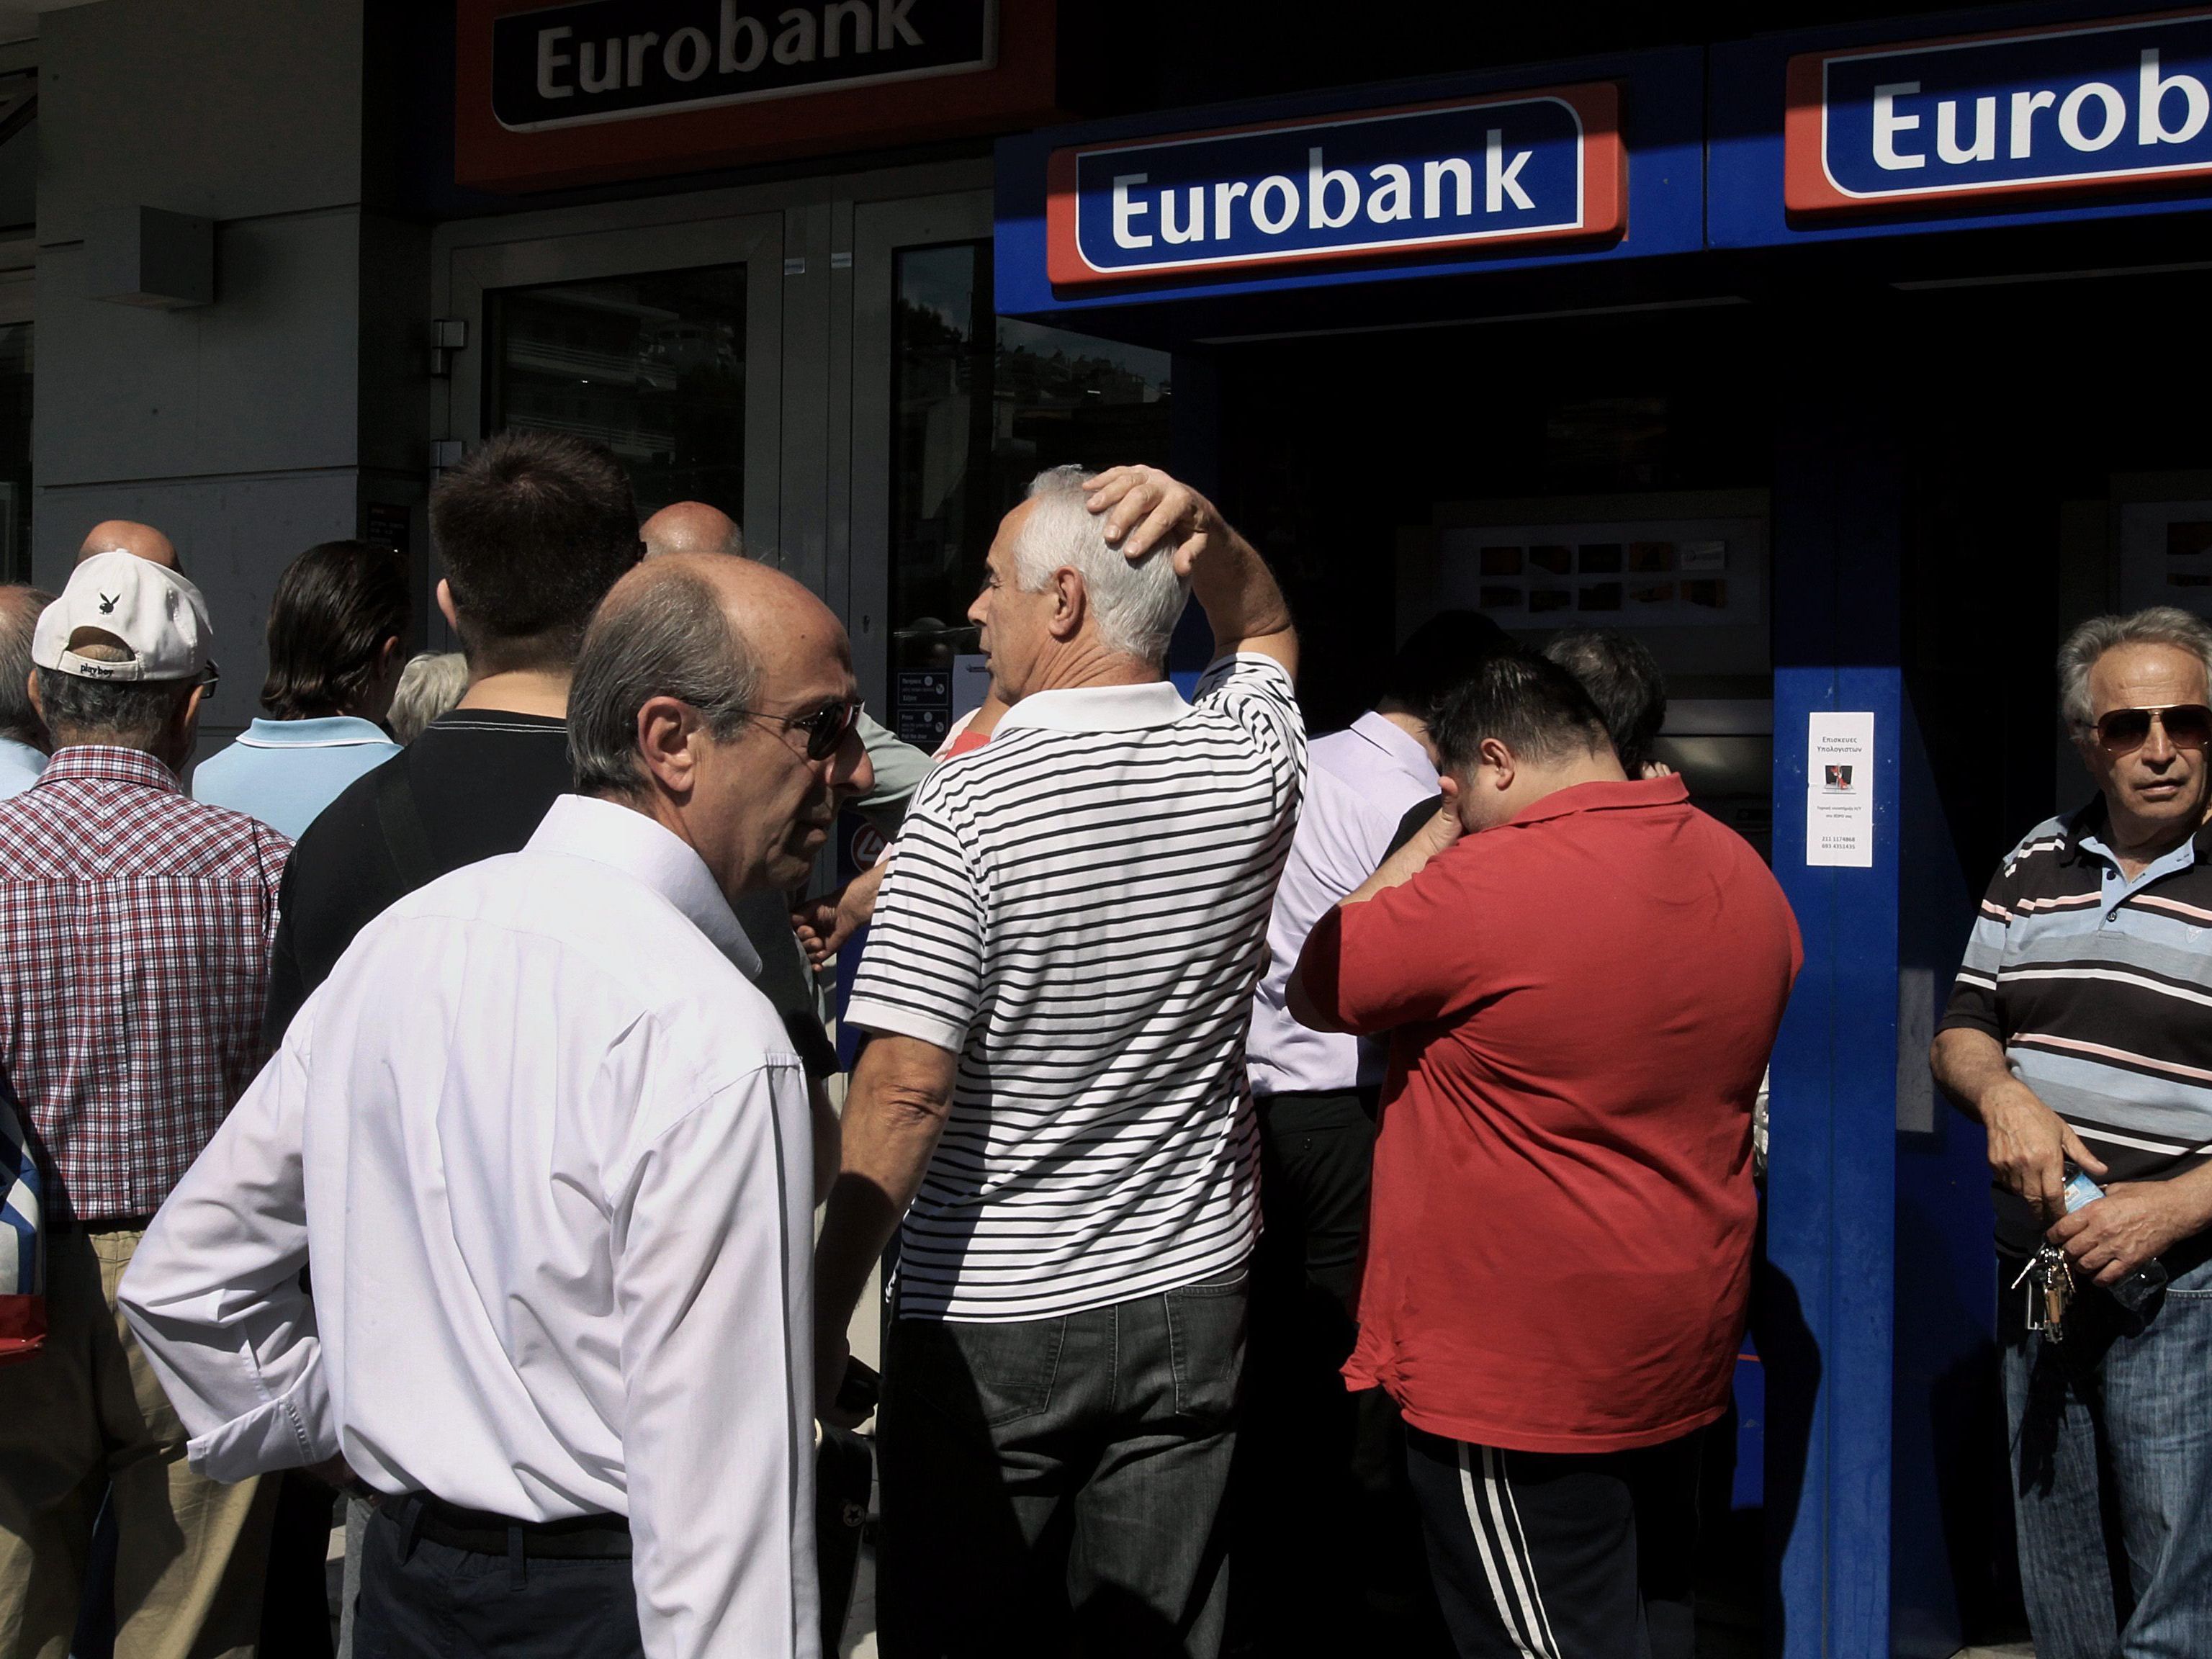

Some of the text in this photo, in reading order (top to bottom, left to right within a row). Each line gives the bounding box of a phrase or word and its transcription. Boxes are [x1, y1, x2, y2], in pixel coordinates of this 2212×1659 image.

[536, 0, 925, 100] Eurobank
[1872, 48, 2211, 171] Eurob
[1112, 128, 1536, 249] Eurobank
[81, 662, 114, 678] playboy
